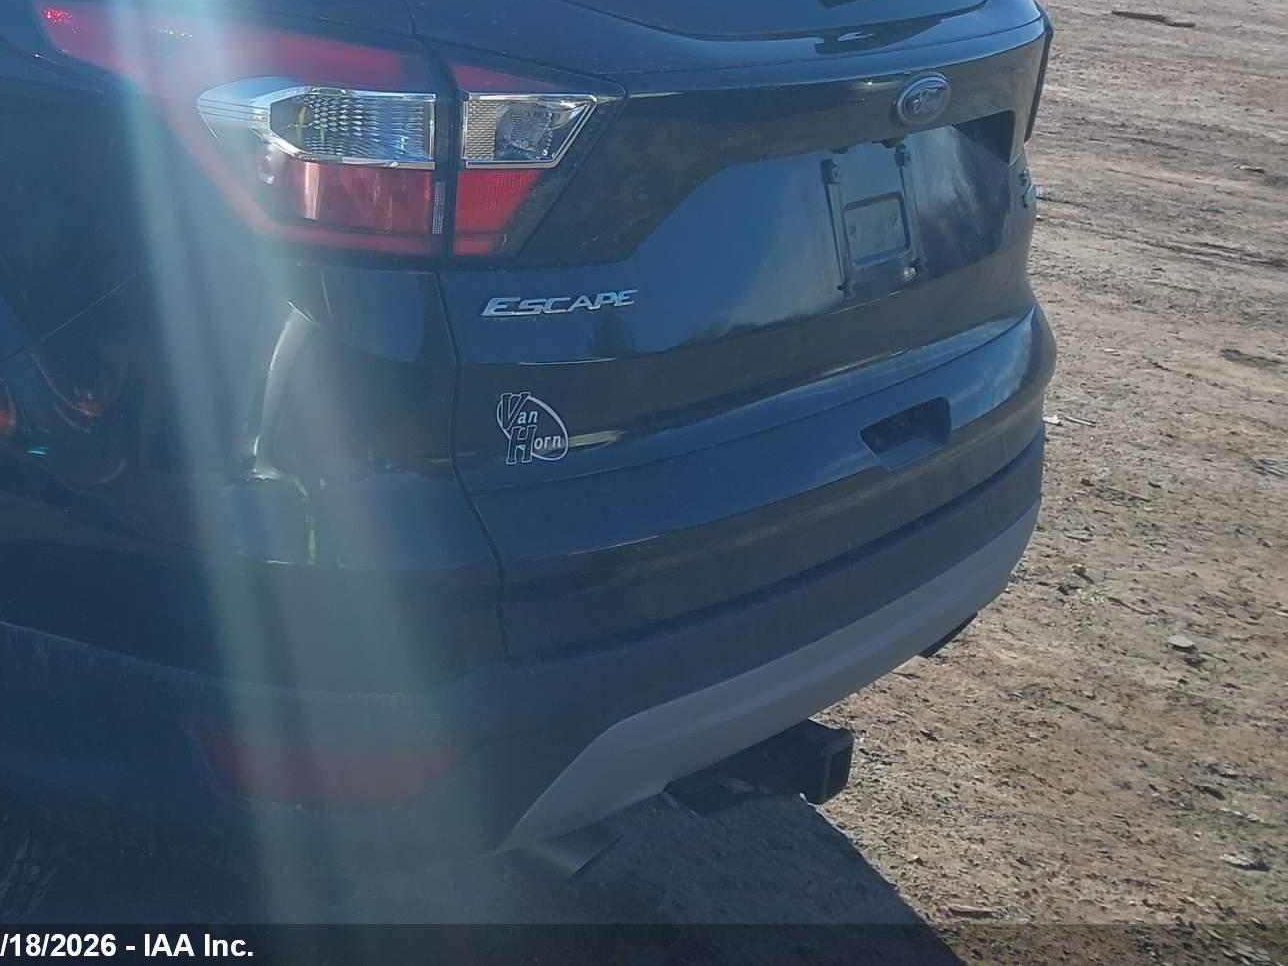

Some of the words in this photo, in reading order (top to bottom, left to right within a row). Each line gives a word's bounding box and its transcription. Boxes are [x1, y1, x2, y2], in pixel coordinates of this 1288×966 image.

[480, 289, 639, 317] ESCAPE
[500, 391, 538, 431] Van
[505, 424, 562, 465] Horn
